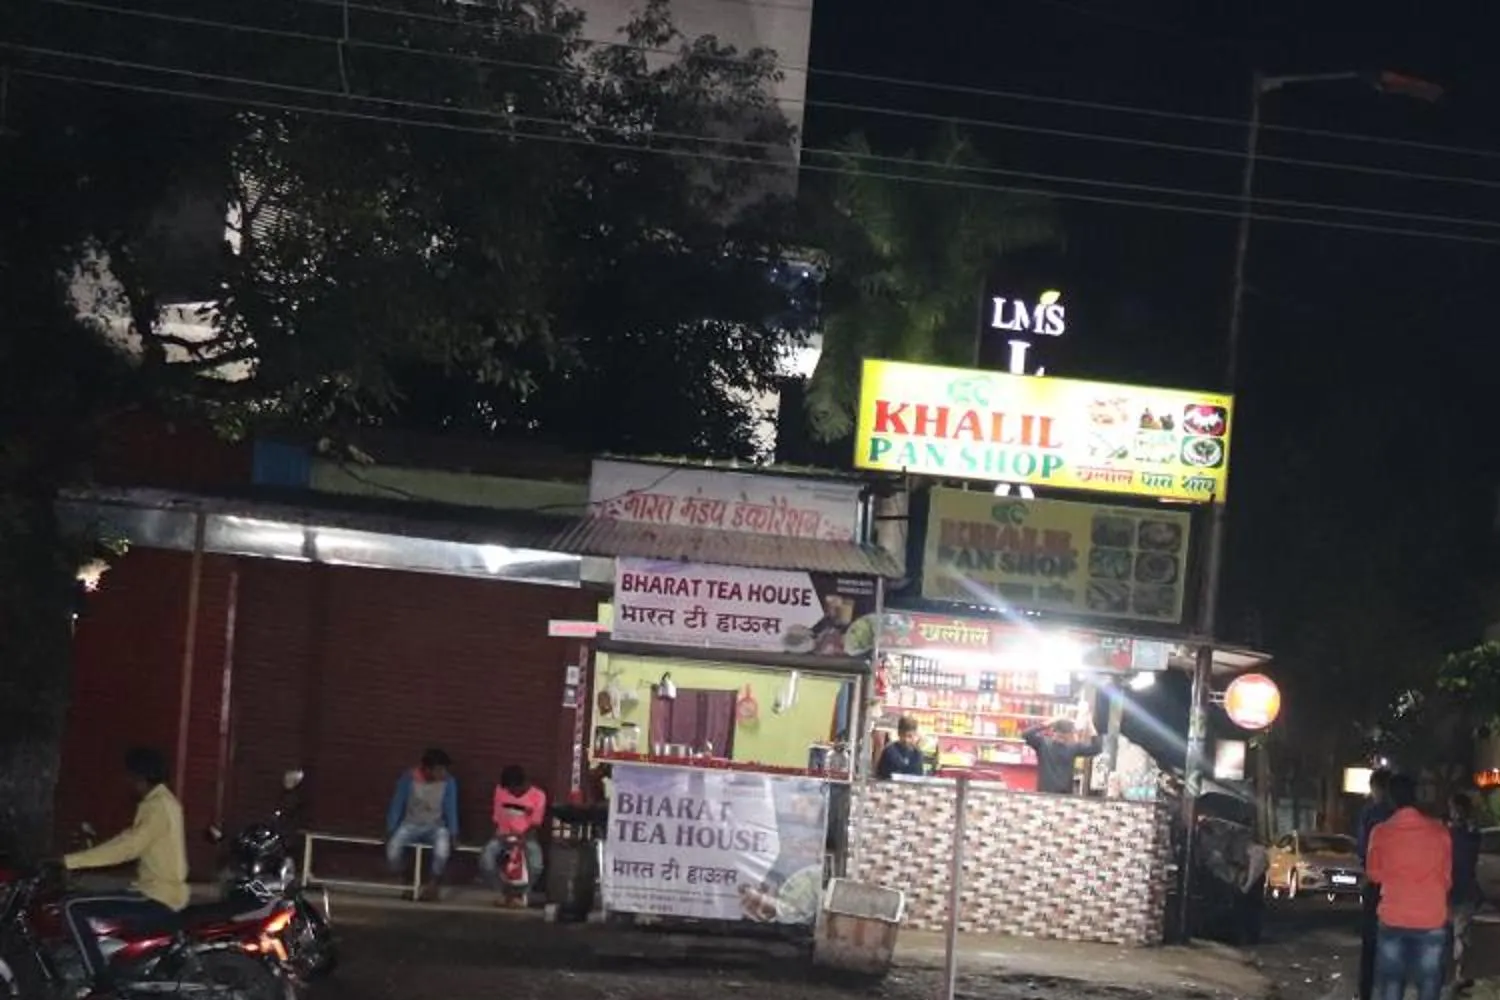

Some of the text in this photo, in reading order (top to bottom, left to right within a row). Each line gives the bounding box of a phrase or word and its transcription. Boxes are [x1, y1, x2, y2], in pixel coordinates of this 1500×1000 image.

[992, 297, 1066, 337] LMS
[874, 399, 1064, 449] KHALIL
[868, 437, 1065, 479] PAN SHOP
[621, 573, 702, 598] BHARAT
[707, 579, 743, 602] TEA
[747, 584, 813, 606] HOUSE
[620, 603, 782, 634] भारत टी हाऊस
[616, 791, 732, 822] BHARAT
[615, 819, 769, 854] TEA HOUSE
[612, 856, 738, 886] भारत टी हाऊस
